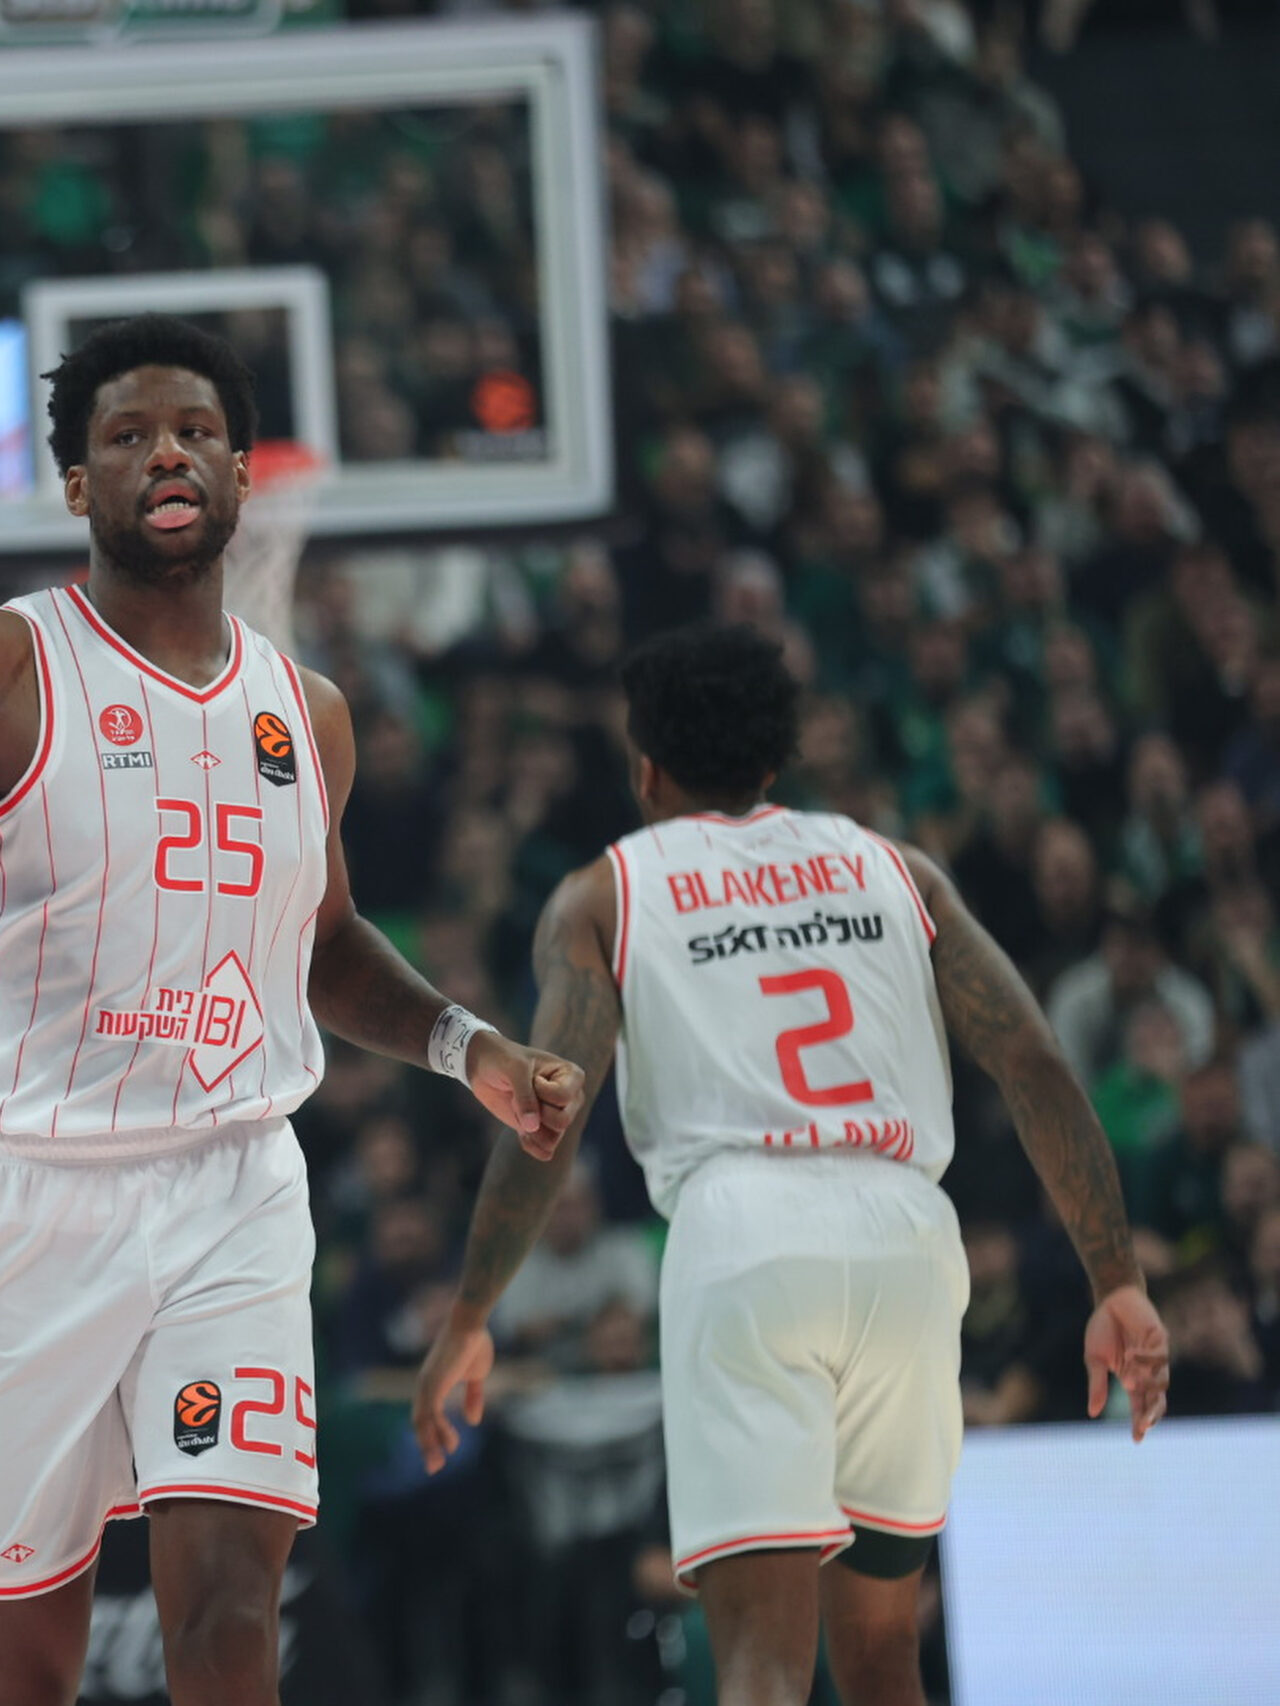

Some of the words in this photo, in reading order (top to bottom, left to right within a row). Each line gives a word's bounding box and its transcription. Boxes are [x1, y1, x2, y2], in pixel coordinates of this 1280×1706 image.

[103, 753, 151, 768] RTMI
[153, 797, 266, 898] 25
[667, 854, 866, 914] BLAKENEY
[96, 1010, 188, 1041] השקעות
[156, 988, 194, 1014] בית
[194, 994, 246, 1049] IBI
[758, 968, 874, 1107] 2
[230, 1366, 317, 1470] 25
